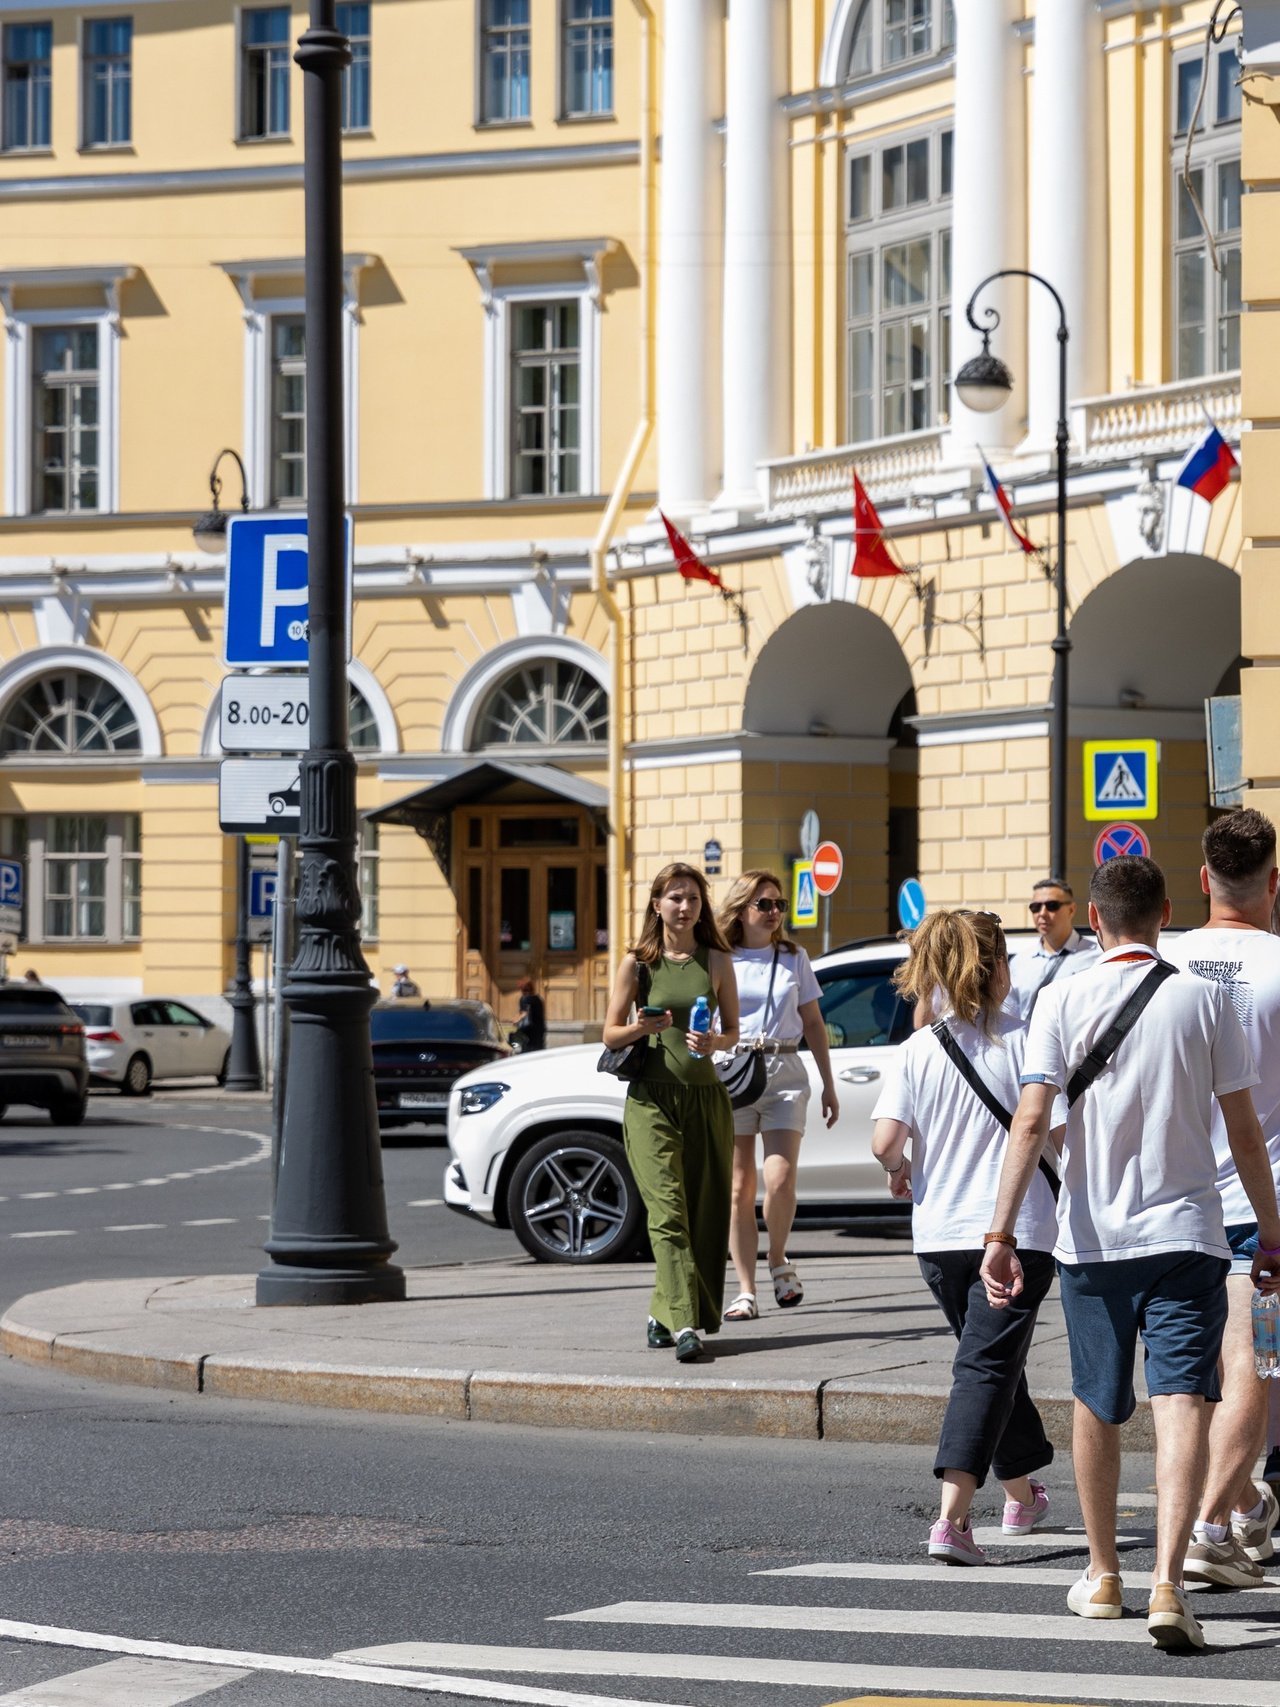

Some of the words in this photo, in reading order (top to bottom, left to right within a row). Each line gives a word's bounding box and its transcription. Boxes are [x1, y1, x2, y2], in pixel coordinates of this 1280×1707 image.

[260, 533, 309, 647] P
[227, 700, 309, 725] 8.00-20
[1188, 960, 1243, 970] UNSTOPPABLE
